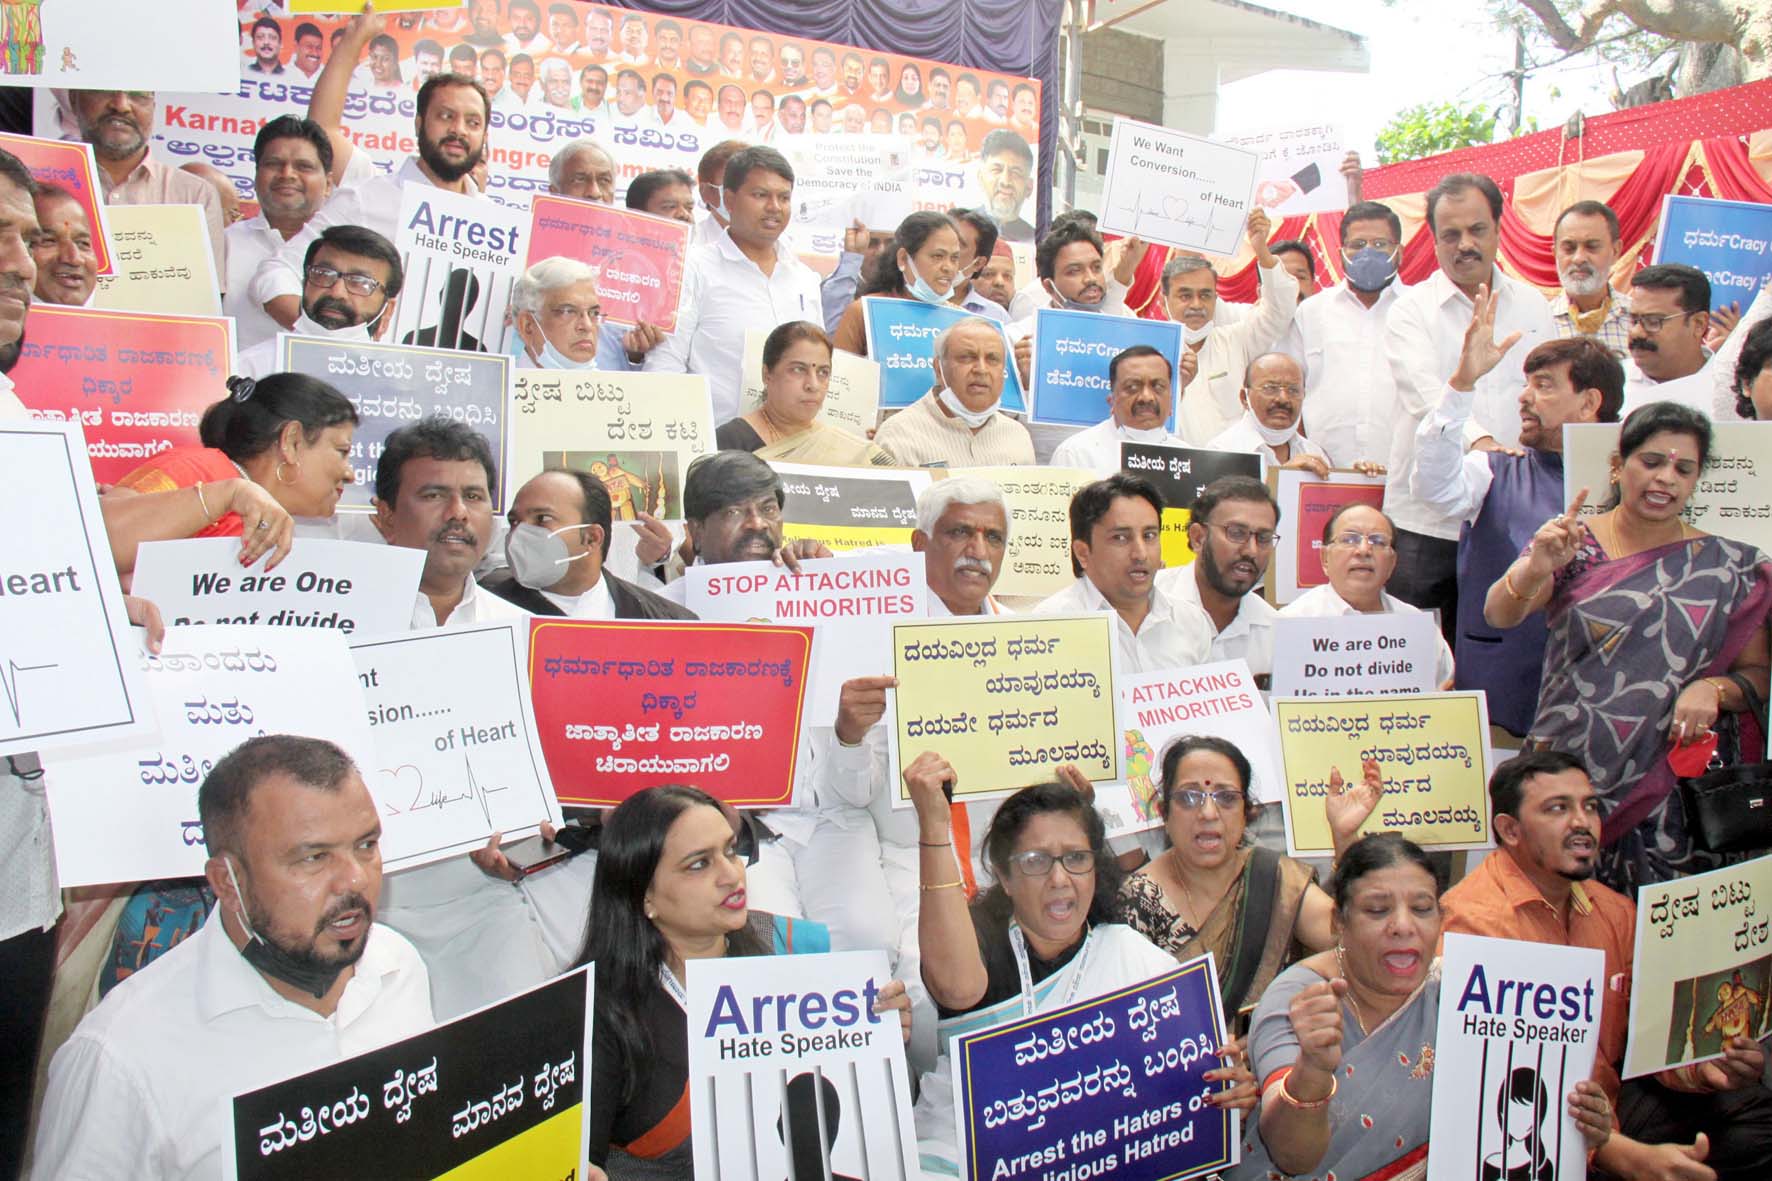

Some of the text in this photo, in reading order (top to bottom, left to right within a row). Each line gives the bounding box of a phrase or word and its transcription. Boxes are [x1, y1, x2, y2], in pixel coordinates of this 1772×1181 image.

[613, 123, 700, 153] ಸಮಿತಿ
[1133, 136, 1184, 158] We Want
[796, 178, 858, 190] Democracy
[827, 167, 873, 178] Save the
[1200, 191, 1244, 210] of Heart
[408, 200, 519, 254] Arrest
[415, 233, 509, 266] Hate Speaker
[327, 352, 473, 395] ಮತೀಯ ದ್ವೇಷ
[607, 418, 654, 442] ದೇಶ
[1127, 453, 1165, 471] ಮತೀಯ
[192, 571, 352, 596] We are One
[707, 567, 911, 596] STOP ATTACKING
[776, 594, 915, 618] MINORITIES
[904, 634, 1061, 668] ದಯವಿಲ್ಲದ ಧರ್ಮ
[1313, 636, 1406, 652] We are One
[544, 655, 793, 687] ಧರ್ಮಾಧಾರಿತ ರಾಜಕಾರಣಕ್ಕೆ
[986, 668, 1101, 698] ಯಾವುದಯ್ಯಾ
[1304, 660, 1413, 678] Do not divide
[1132, 672, 1242, 704] ATTACKING
[641, 691, 697, 720] ಧಿಕ್ಕಾರ
[1137, 693, 1253, 728] MINORITIES
[434, 720, 517, 752] of Heart
[565, 721, 763, 750] ಜಾತ್ಯಾತೀತ ರಾಜಕಾರಣ
[907, 706, 1058, 737] ದಯವೇ ಧರ್ಮದ
[1288, 712, 1431, 740] ದಯವಿಲ್ಲದ ಧರ್ಮ
[595, 752, 730, 774] ಚಿರಾಯುವಾಗಲಿ
[1008, 738, 1111, 769] ಮೂಲವಯ್ಯ
[1382, 805, 1481, 832] ಮೂಲವಯ್ಯ
[1650, 886, 1700, 939] ದ್ವೇಷ
[1735, 914, 1770, 952] ದೇಶ
[704, 977, 882, 1037] Arrest
[1457, 964, 1594, 1023] Arrest
[1014, 985, 1181, 1067] ಮತೀಯ ದ್ವೇಷ
[1464, 1013, 1587, 1045] Hate Speaker
[720, 1029, 873, 1060] Hate Speaker
[451, 1051, 576, 1139] ಮಾನವ ದ್ವೇಷ
[983, 1033, 1215, 1133] ಬಿತ್ತುವವರನ್ನು ಬಂಧಿಸಿ
[259, 1056, 439, 1156] ಮತೀಯ ದ್ವೇಷ
[991, 1139, 1065, 1181] Arrest
[1071, 1127, 1107, 1154] the
[1113, 1104, 1182, 1140] Haters
[1124, 1121, 1194, 1165] Hatred
